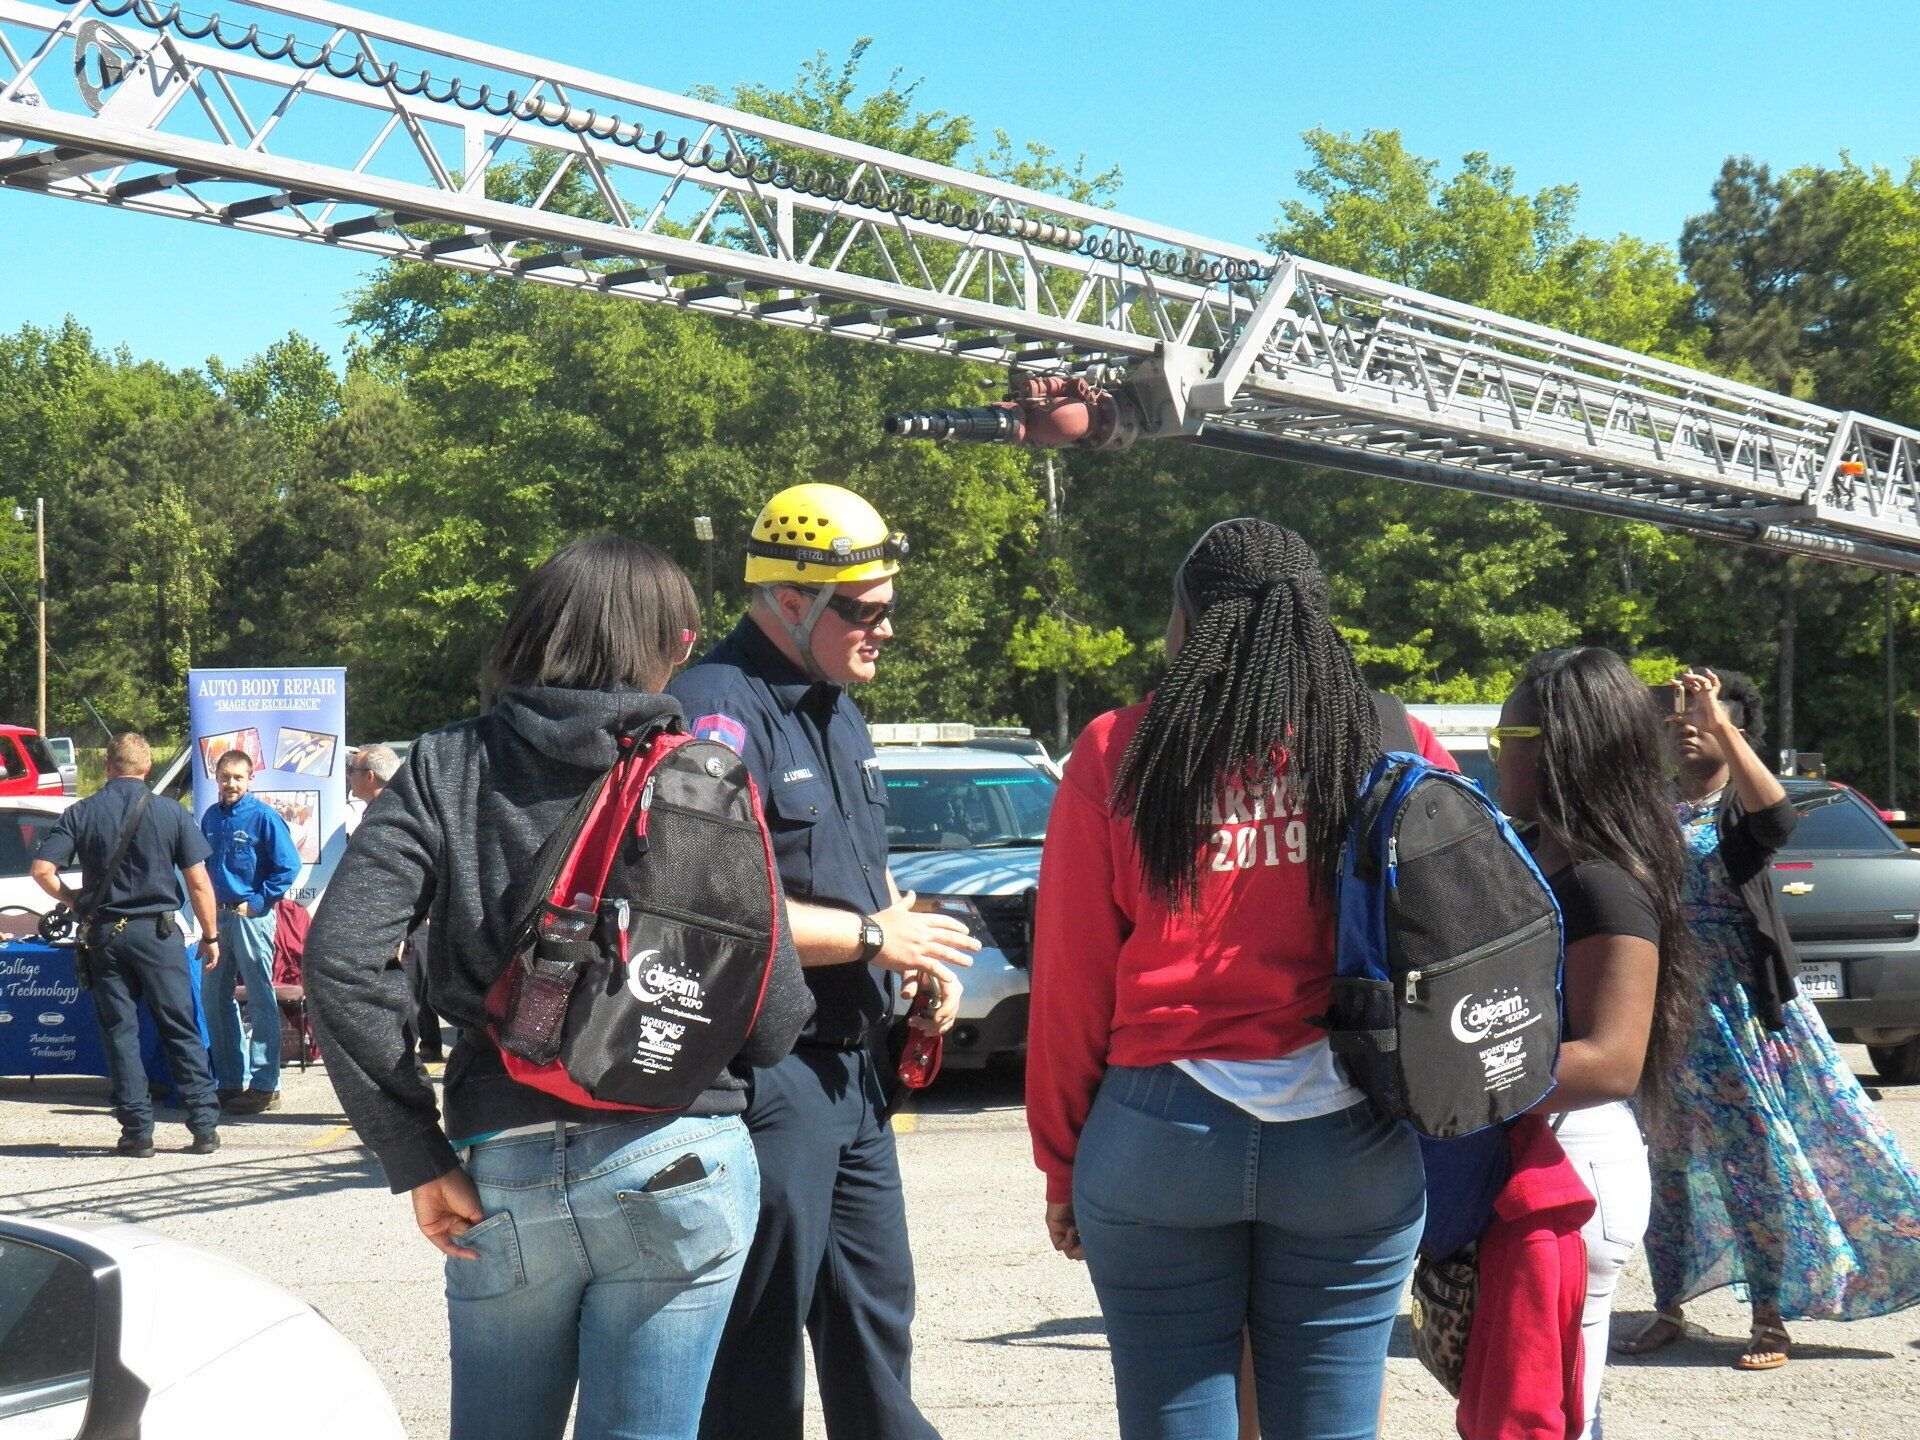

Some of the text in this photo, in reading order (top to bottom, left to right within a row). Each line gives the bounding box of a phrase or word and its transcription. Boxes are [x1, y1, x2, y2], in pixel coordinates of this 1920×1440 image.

[799, 549, 823, 560] PETZL
[199, 678, 337, 697] AUTO BODY REPAIR
[247, 699, 260, 710] OF
[1212, 820, 1308, 872] 2019
[290, 887, 317, 900] FIRST
[0, 957, 40, 983] College
[1797, 964, 1819, 972] EXAS
[645, 962, 700, 999] dream
[7, 979, 79, 1005] Technology
[679, 996, 704, 1010] EXPO
[1468, 995, 1523, 1027] dream
[640, 1014, 687, 1035] WORKFORCE
[1507, 1007, 1530, 1024] EXPO
[29, 1033, 76, 1043] Automotive
[30, 1045, 76, 1061] Technology
[1479, 1036, 1524, 1059] WORKFORCE
